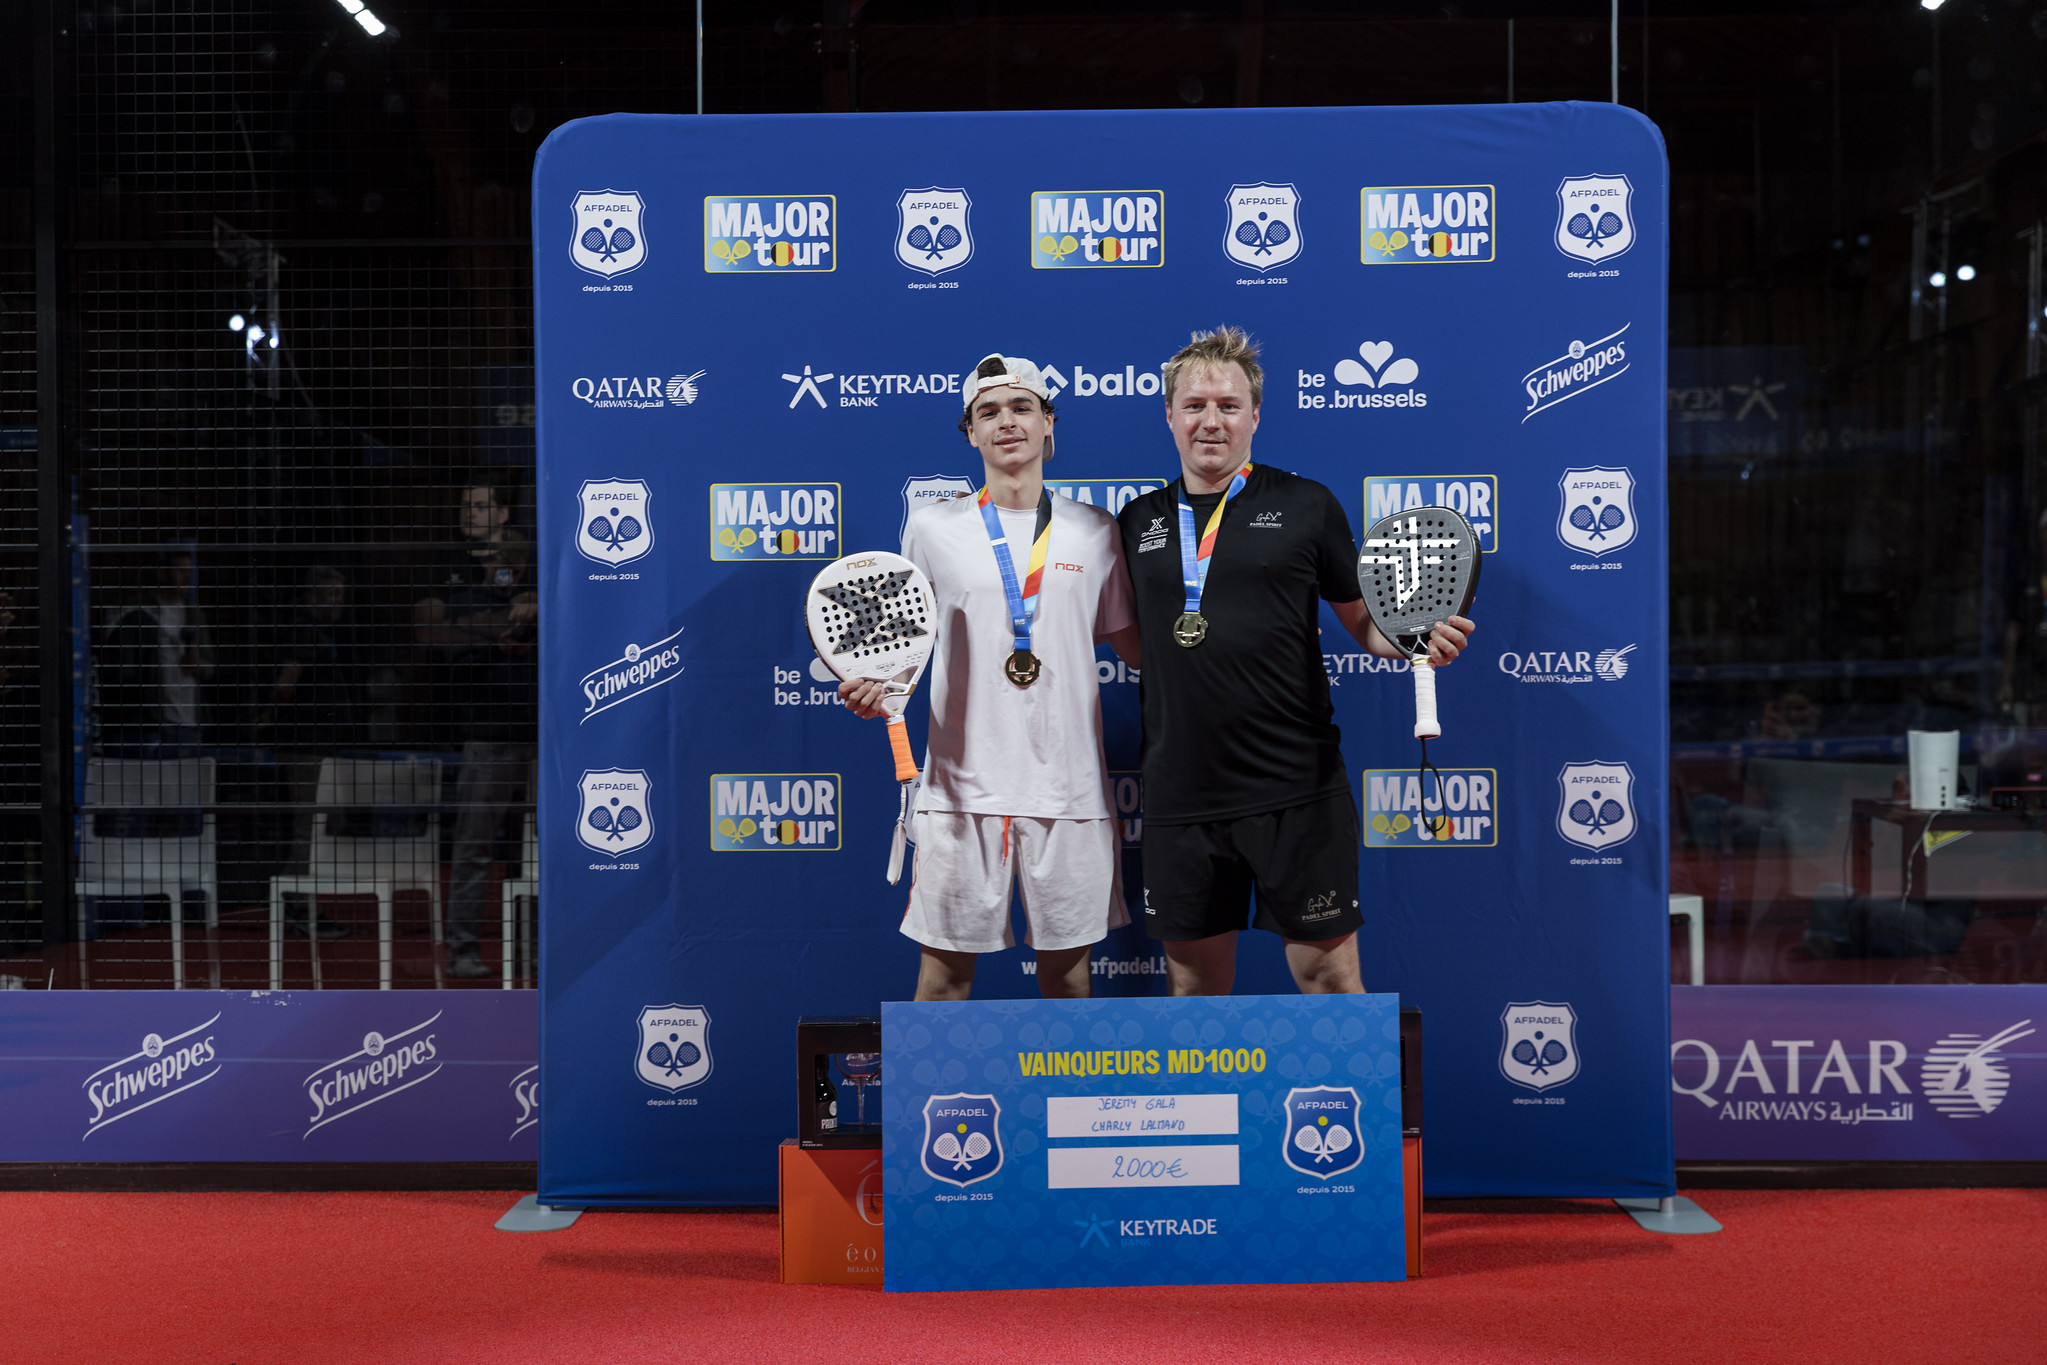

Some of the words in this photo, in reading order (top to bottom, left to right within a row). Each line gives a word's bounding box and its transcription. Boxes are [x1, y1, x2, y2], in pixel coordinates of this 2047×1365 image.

[1570, 188, 1620, 198] AFPADEL
[910, 201, 959, 210] AFPADEL
[1238, 197, 1288, 206] AFPADEL
[584, 204, 633, 213] AFPADEL
[1368, 192, 1488, 229] MAJOR
[712, 201, 830, 238] MAJOR
[1038, 197, 1158, 234] MAJOR
[1567, 270, 1596, 279] depuis
[1599, 269, 1620, 278] 2015
[907, 282, 936, 290] depuis
[938, 281, 959, 290] 2015
[1235, 277, 1265, 286] depuis
[1267, 276, 1288, 285] 2015
[582, 285, 611, 294] depuis
[612, 284, 633, 292] 2015
[1299, 368, 1326, 389] be
[1525, 339, 1626, 412] Schweppes
[572, 376, 663, 403] QATAR
[840, 373, 960, 396] KEYTRADE
[594, 399, 634, 409] AIRWAYS
[840, 396, 878, 407] BANK
[1572, 480, 1622, 490] AFPADEL
[590, 492, 640, 501] AFPADEL
[914, 490, 961, 498] AFPADE
[717, 489, 835, 525] MAJOR
[1570, 562, 1598, 571] depuis
[1601, 561, 1622, 571] 2015
[588, 573, 617, 582] depuis
[619, 572, 640, 581] 2015
[1322, 654, 1415, 674] EYTRAD
[1499, 651, 1592, 679] QATAR
[583, 644, 680, 713] Schweppes
[774, 666, 801, 684] be
[1520, 674, 1561, 684] AIRWAYS
[1571, 775, 1622, 785] AFPADEL
[591, 782, 639, 791] AFPADEL
[717, 780, 835, 815] MAJOR
[1371, 776, 1491, 812] MAJOR
[1570, 857, 1598, 866] depuis
[1601, 856, 1622, 865] 2015
[588, 863, 617, 872] depuis
[619, 862, 640, 871] 2015
[649, 1019, 700, 1027] AFPADEL
[1514, 1016, 1564, 1025] AFPADEL
[1018, 1049, 1161, 1078] VAINQUEURS
[1168, 1047, 1267, 1075] MD1000
[309, 1033, 437, 1123] Schweppes
[1671, 1038, 1913, 1107] QATAR
[88, 1035, 216, 1124] Schweppes
[647, 1098, 677, 1107] depuis
[678, 1098, 699, 1106] 2015
[1098, 1097, 1137, 1111] JEREMY
[1145, 1097, 1176, 1111] GALA
[1296, 1101, 1349, 1112] AFPADEL
[1513, 1097, 1541, 1106] depuis
[1544, 1096, 1566, 1105] 2015
[935, 1107, 989, 1118] AFPADEL
[1719, 1101, 1828, 1121] AIRWAYS
[1829, 1102, 1914, 1125] القطرية
[1091, 1120, 1132, 1133] CHARLY
[1112, 1155, 1189, 1179] 2000€
[1296, 1185, 1330, 1195] depuis
[1333, 1184, 1356, 1194] 2015
[934, 1192, 970, 1203] depuis
[972, 1191, 994, 1202] 2015
[1120, 1218, 1218, 1236] KEYTRADE
[1121, 1237, 1151, 1247] BANK
